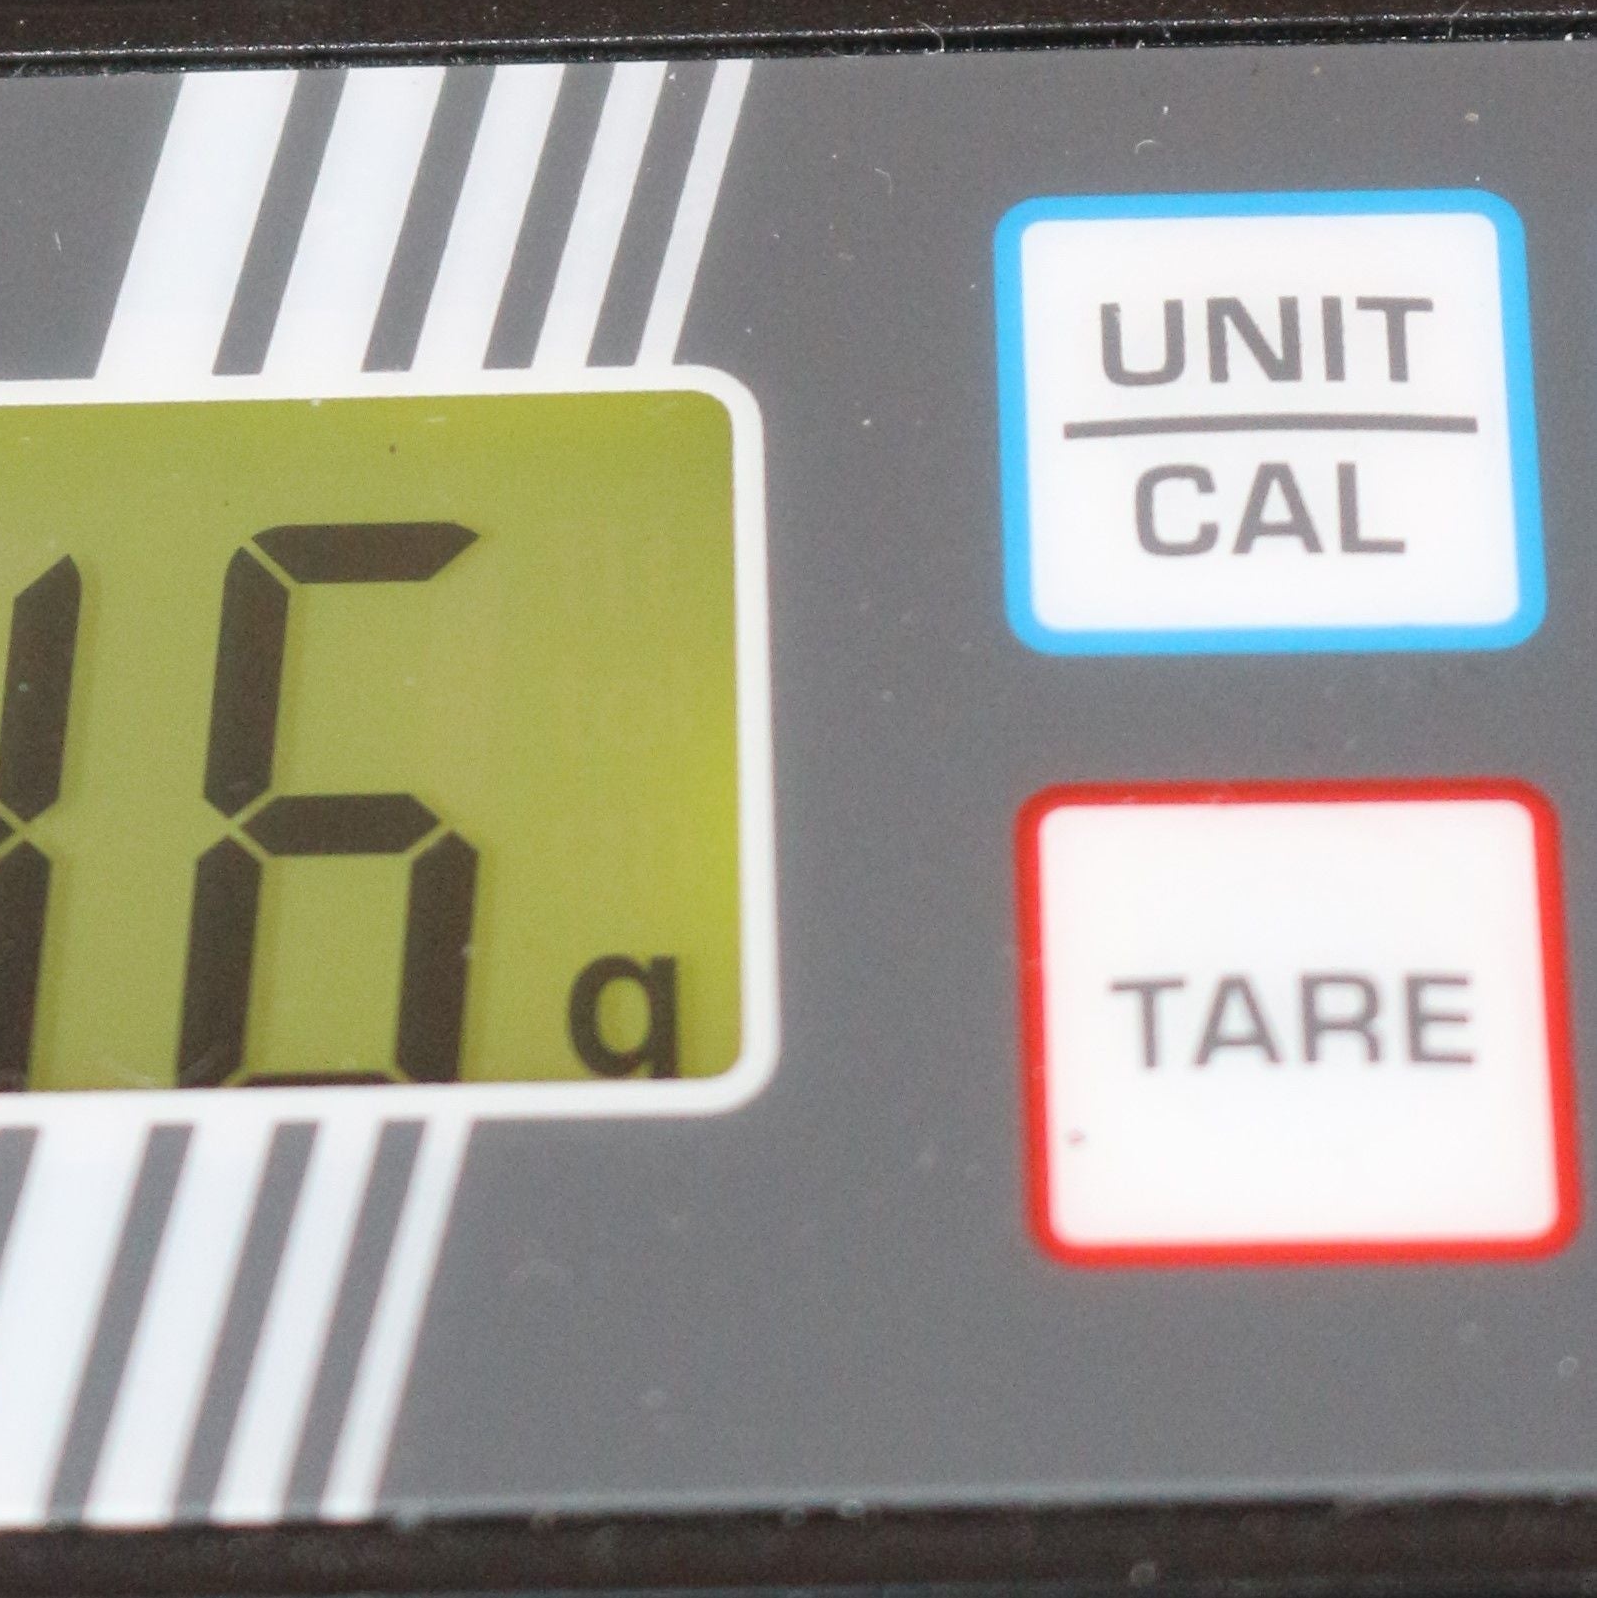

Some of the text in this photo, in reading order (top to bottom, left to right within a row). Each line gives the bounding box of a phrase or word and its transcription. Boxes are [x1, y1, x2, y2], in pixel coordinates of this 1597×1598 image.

[1097, 295, 1434, 388] UNIT
[1132, 461, 1407, 558] CAL
[1107, 971, 1475, 1070] TARE
